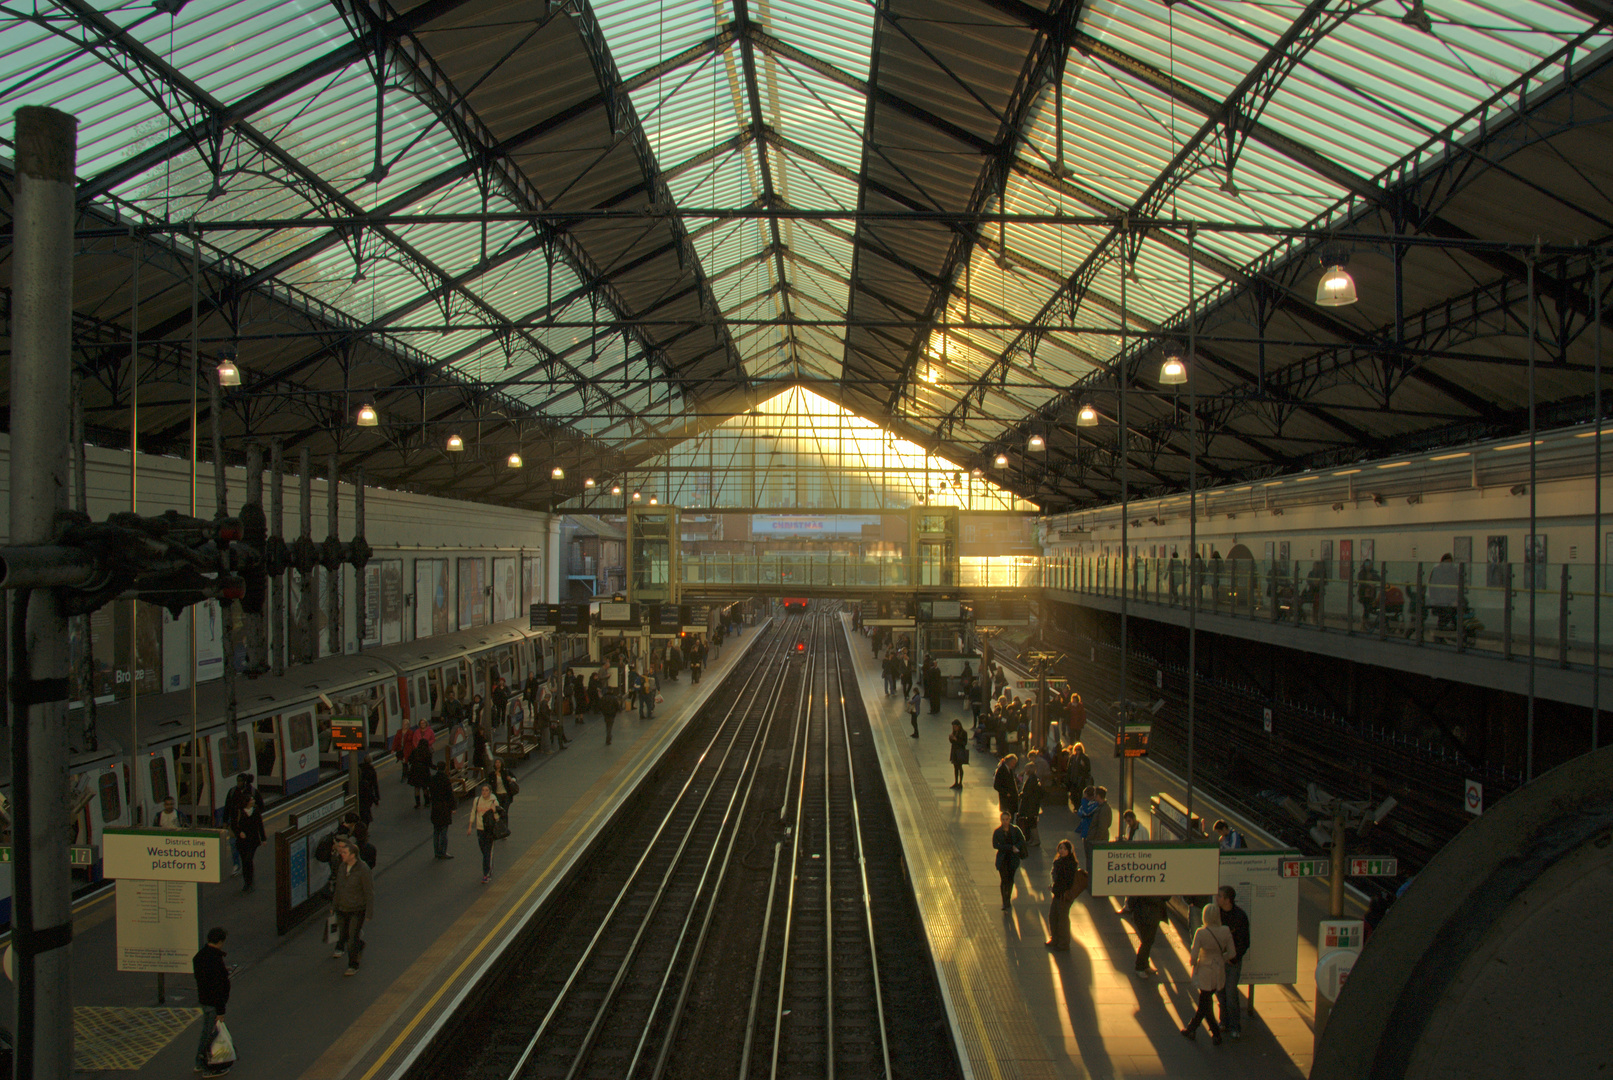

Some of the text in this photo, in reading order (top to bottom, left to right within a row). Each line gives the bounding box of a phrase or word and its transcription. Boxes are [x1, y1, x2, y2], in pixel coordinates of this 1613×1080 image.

[772, 521, 824, 529] CHRISTMAS
[115, 669, 145, 684] Broze
[165, 838, 206, 847] District line
[147, 847, 206, 858] Westbound
[1107, 851, 1152, 859] District line
[151, 860, 206, 871] platform 3
[1107, 861, 1167, 871] Eastbound
[1107, 873, 1166, 885] platform 2
